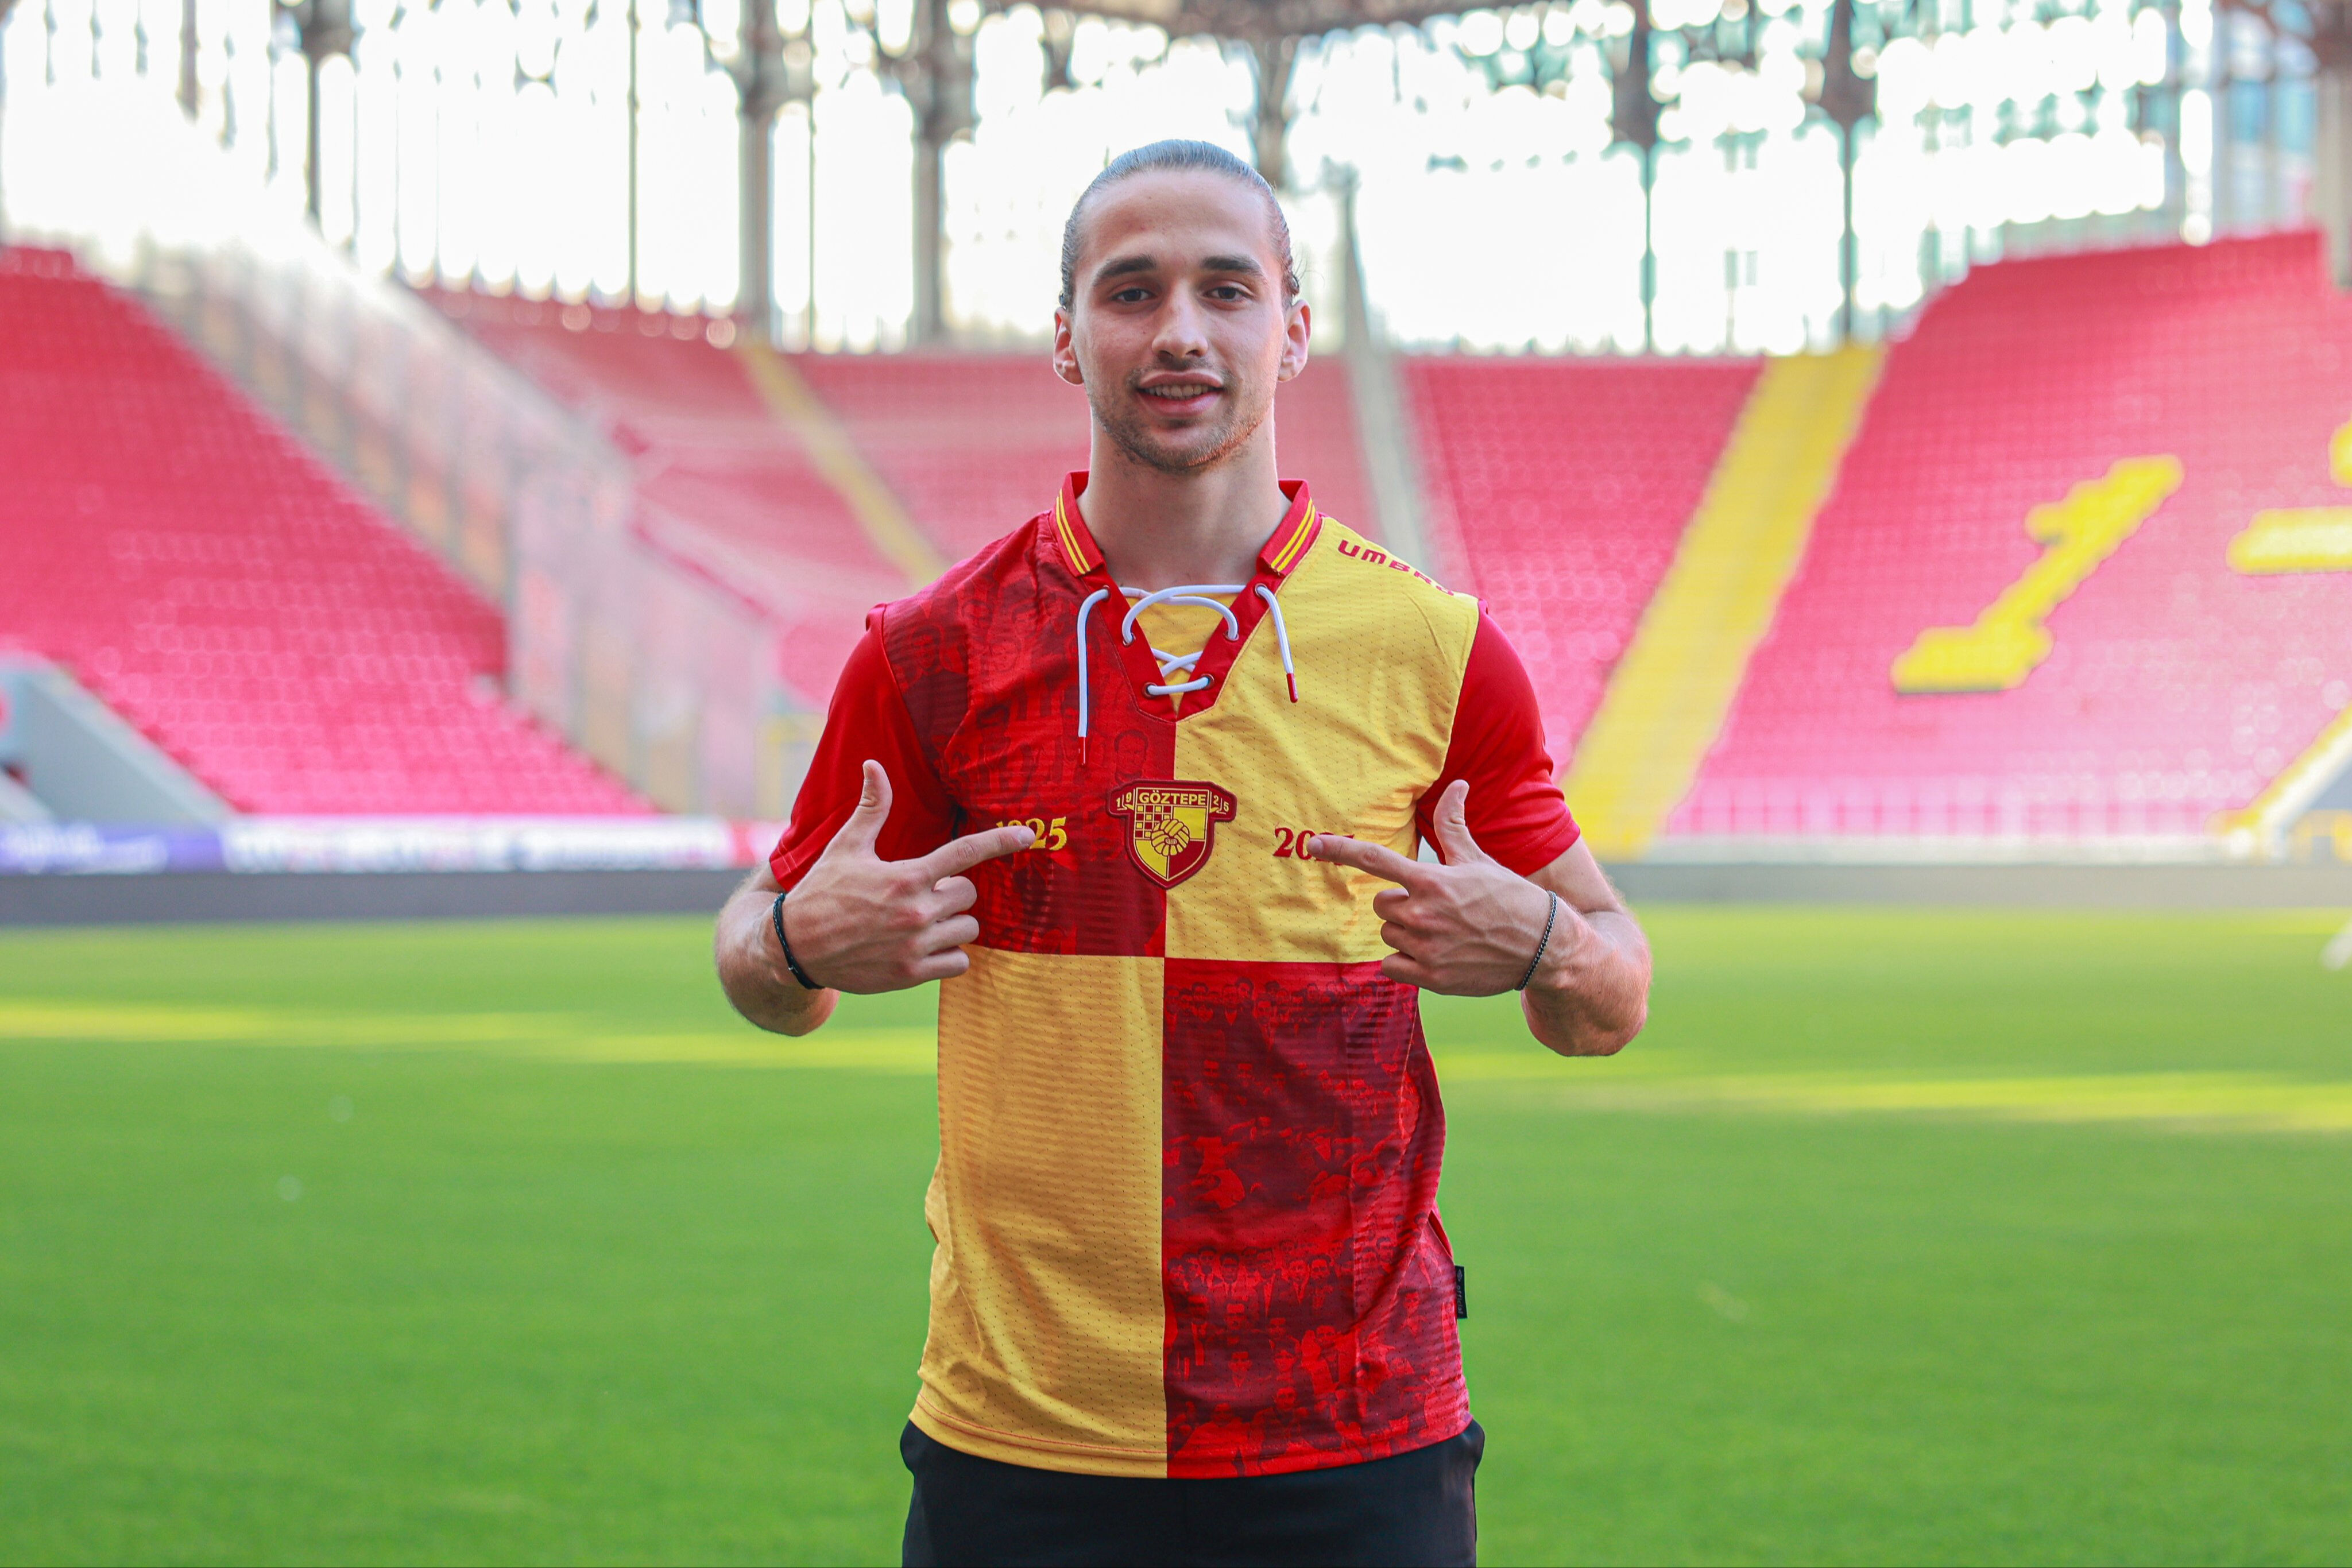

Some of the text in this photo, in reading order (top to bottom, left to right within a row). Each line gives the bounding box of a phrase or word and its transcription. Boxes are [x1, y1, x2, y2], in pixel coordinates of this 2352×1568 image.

[1139, 790, 1206, 806] GÖZTEPE
[996, 816, 1067, 851] 25
[1272, 827, 1355, 866] 20
